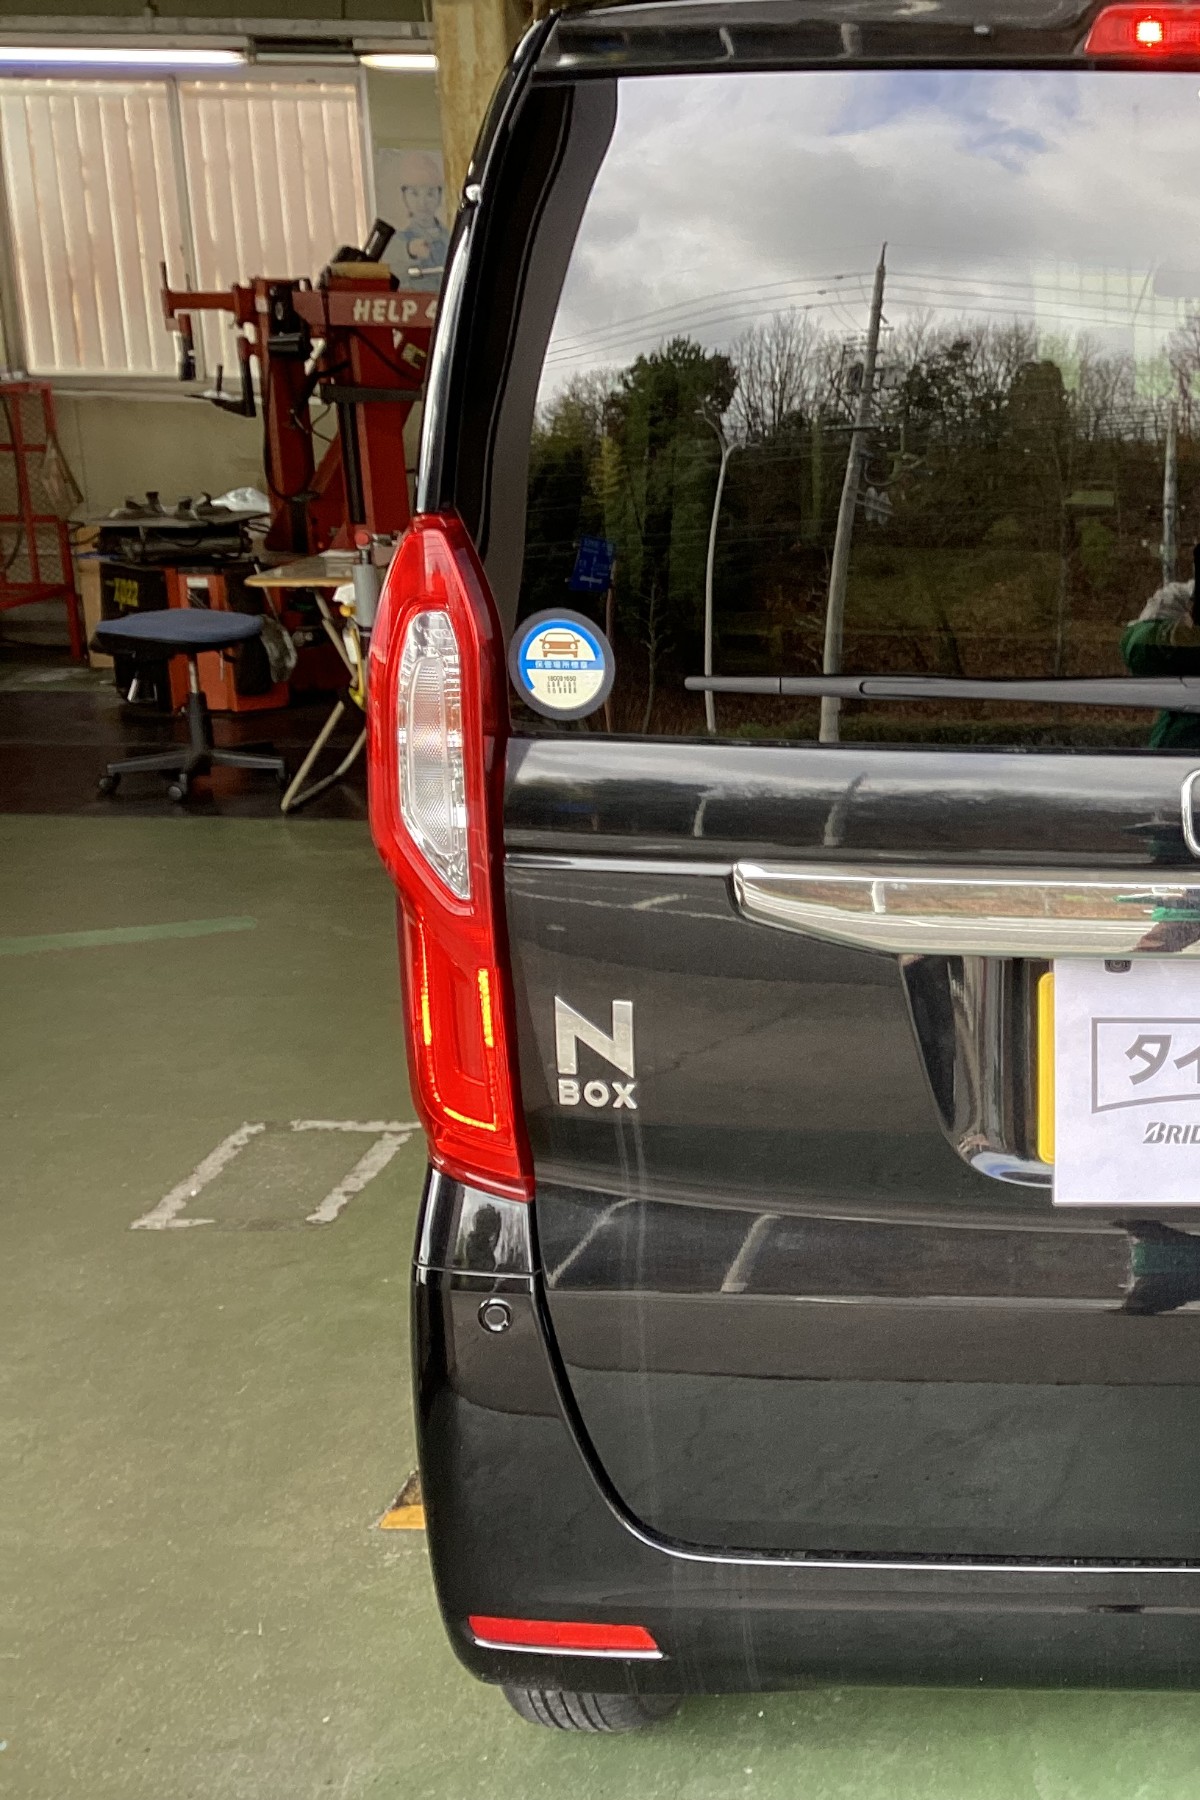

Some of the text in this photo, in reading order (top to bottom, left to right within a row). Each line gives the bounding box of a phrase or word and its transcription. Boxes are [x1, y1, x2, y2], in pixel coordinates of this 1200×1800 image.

[353, 298, 418, 323] HELP
[554, 994, 634, 1079] N
[557, 1079, 638, 1110] BOX
